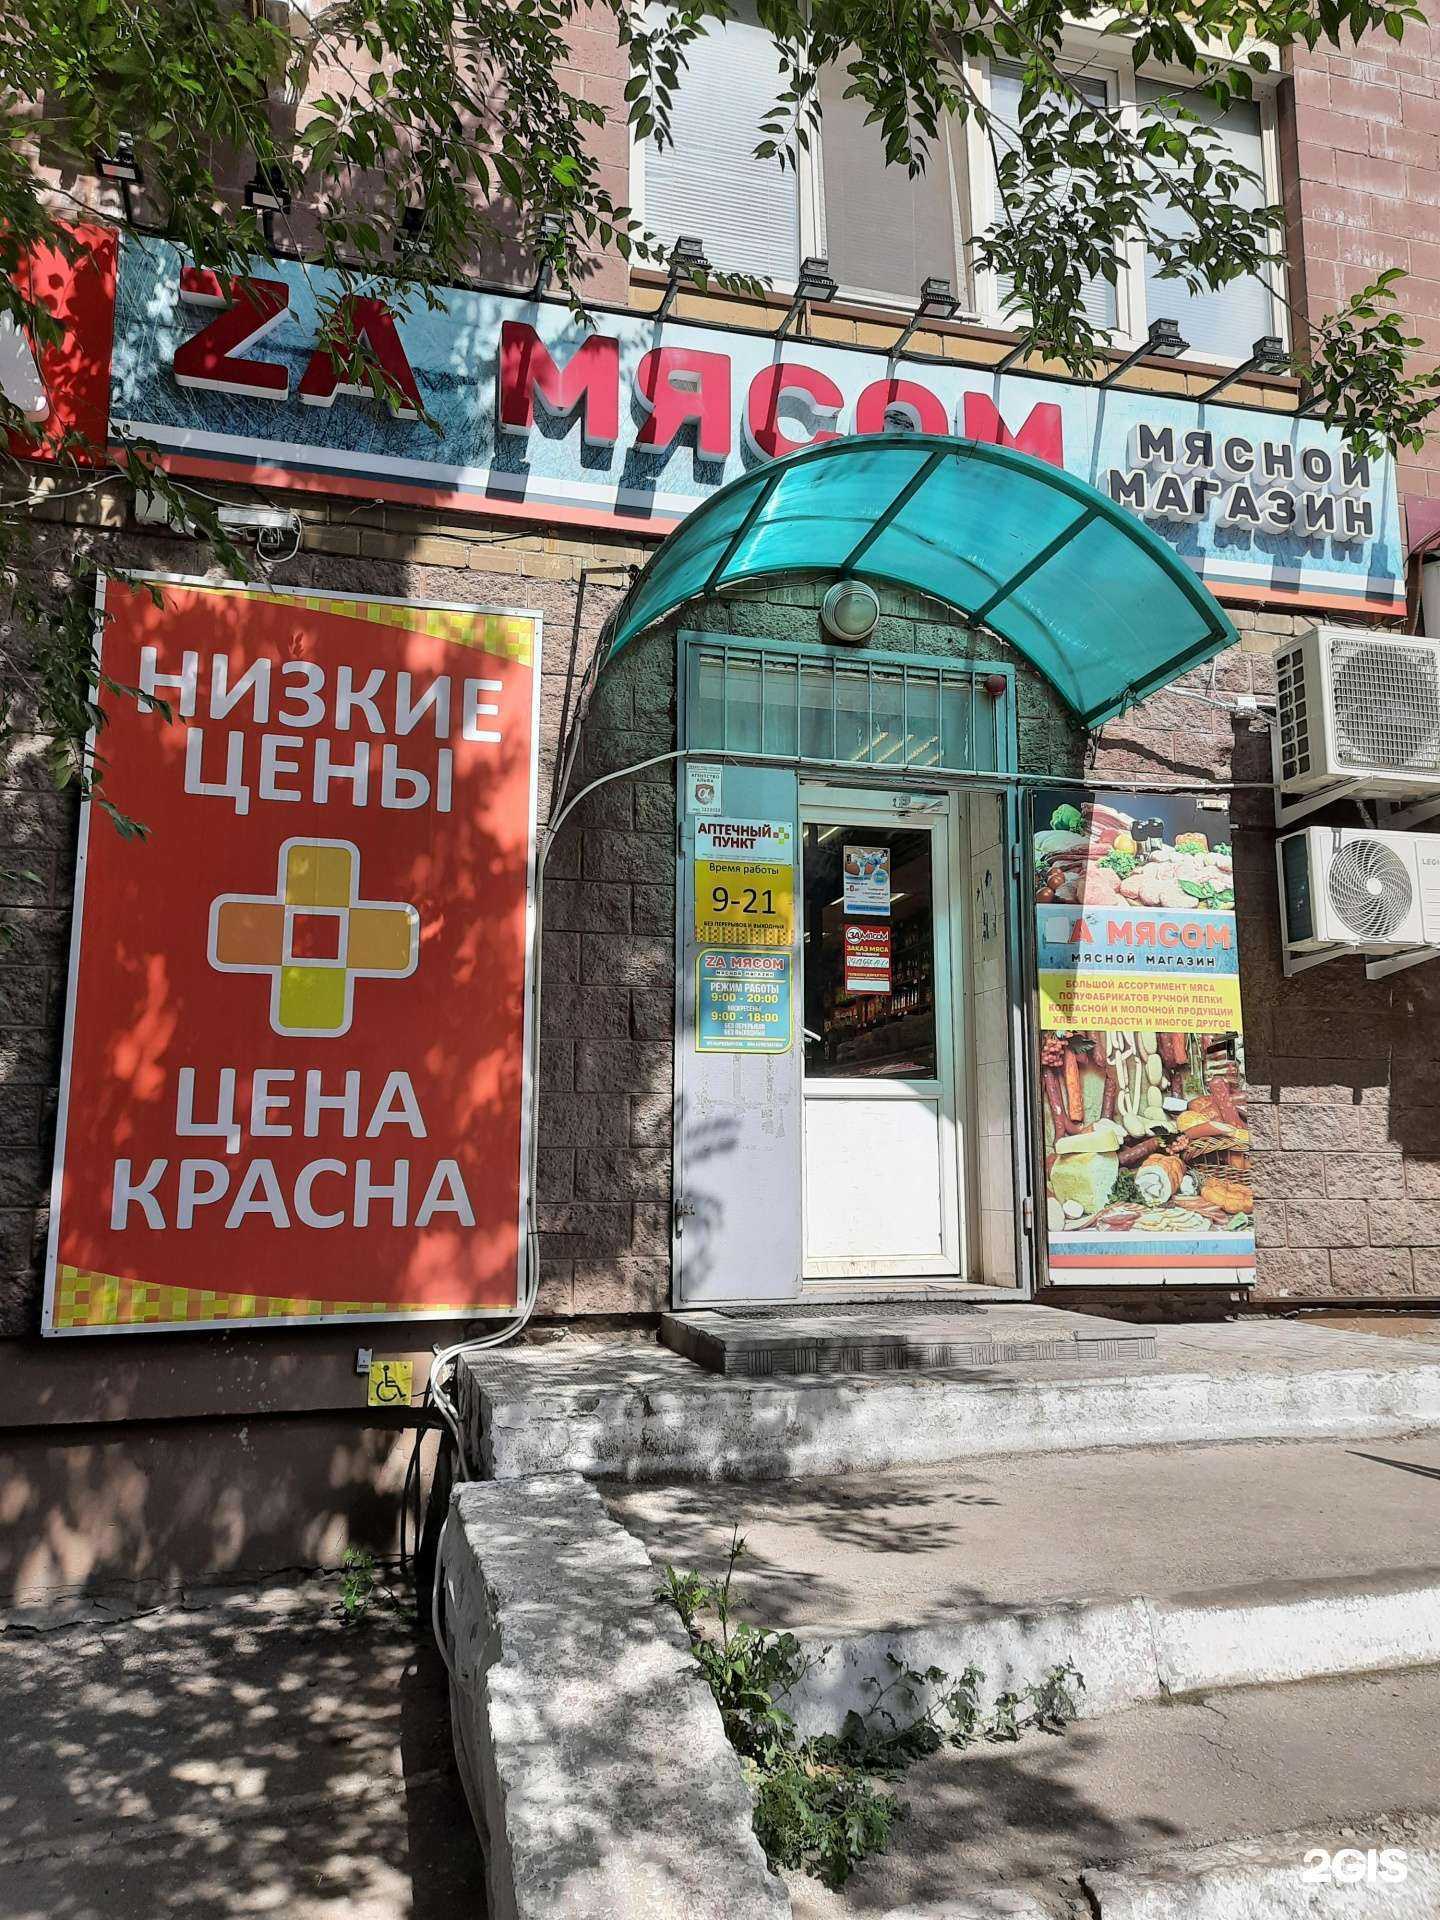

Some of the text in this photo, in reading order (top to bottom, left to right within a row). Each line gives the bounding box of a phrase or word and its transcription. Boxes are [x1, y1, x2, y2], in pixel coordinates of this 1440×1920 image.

[499, 320, 1064, 468] МЯСОМ
[1137, 423, 1372, 489] МЯСНОЙ
[1108, 469, 1374, 537] МАГАЗИН
[137, 646, 504, 744] НИЗКИЕ
[183, 726, 453, 816] ЦЕНЫ
[698, 822, 771, 838] АПТЕЧНЫЙ
[712, 836, 757, 850] ПУНКТ
[709, 862, 779, 875] Время работы
[712, 886, 776, 915] 9-21
[1106, 919, 1232, 951] МЯСОМ
[731, 956, 784, 970] МЯСОМ
[1071, 953, 1216, 967] МЯСНОЙ МАГАЗИН
[710, 981, 780, 994] РЕЖИМ РАБОТЫ
[1065, 979, 1216, 992] БОЛЬШОЙ АССОРТИМЕНТ МЯСА
[711, 992, 736, 1002] 9:00
[746, 993, 779, 1004] 20:00
[1059, 991, 1223, 1005] ПОЛУФАБРИКАТОВ РУЧНОЙ ЛЕПКИ
[711, 1011, 737, 1021] 9:00
[748, 1012, 779, 1023] 18:00
[1048, 1003, 1233, 1018] КОЛБАСНОЙ И МОЛОЧНОЙ ПРОДУКЦИИ
[1052, 1015, 1232, 1030] ХЛЕБ И СЛАДОСТИ И МНОГОЕ ДРУГОЕ
[176, 1066, 429, 1155] ЦЕНА
[109, 1156, 477, 1232] КРАСНА
